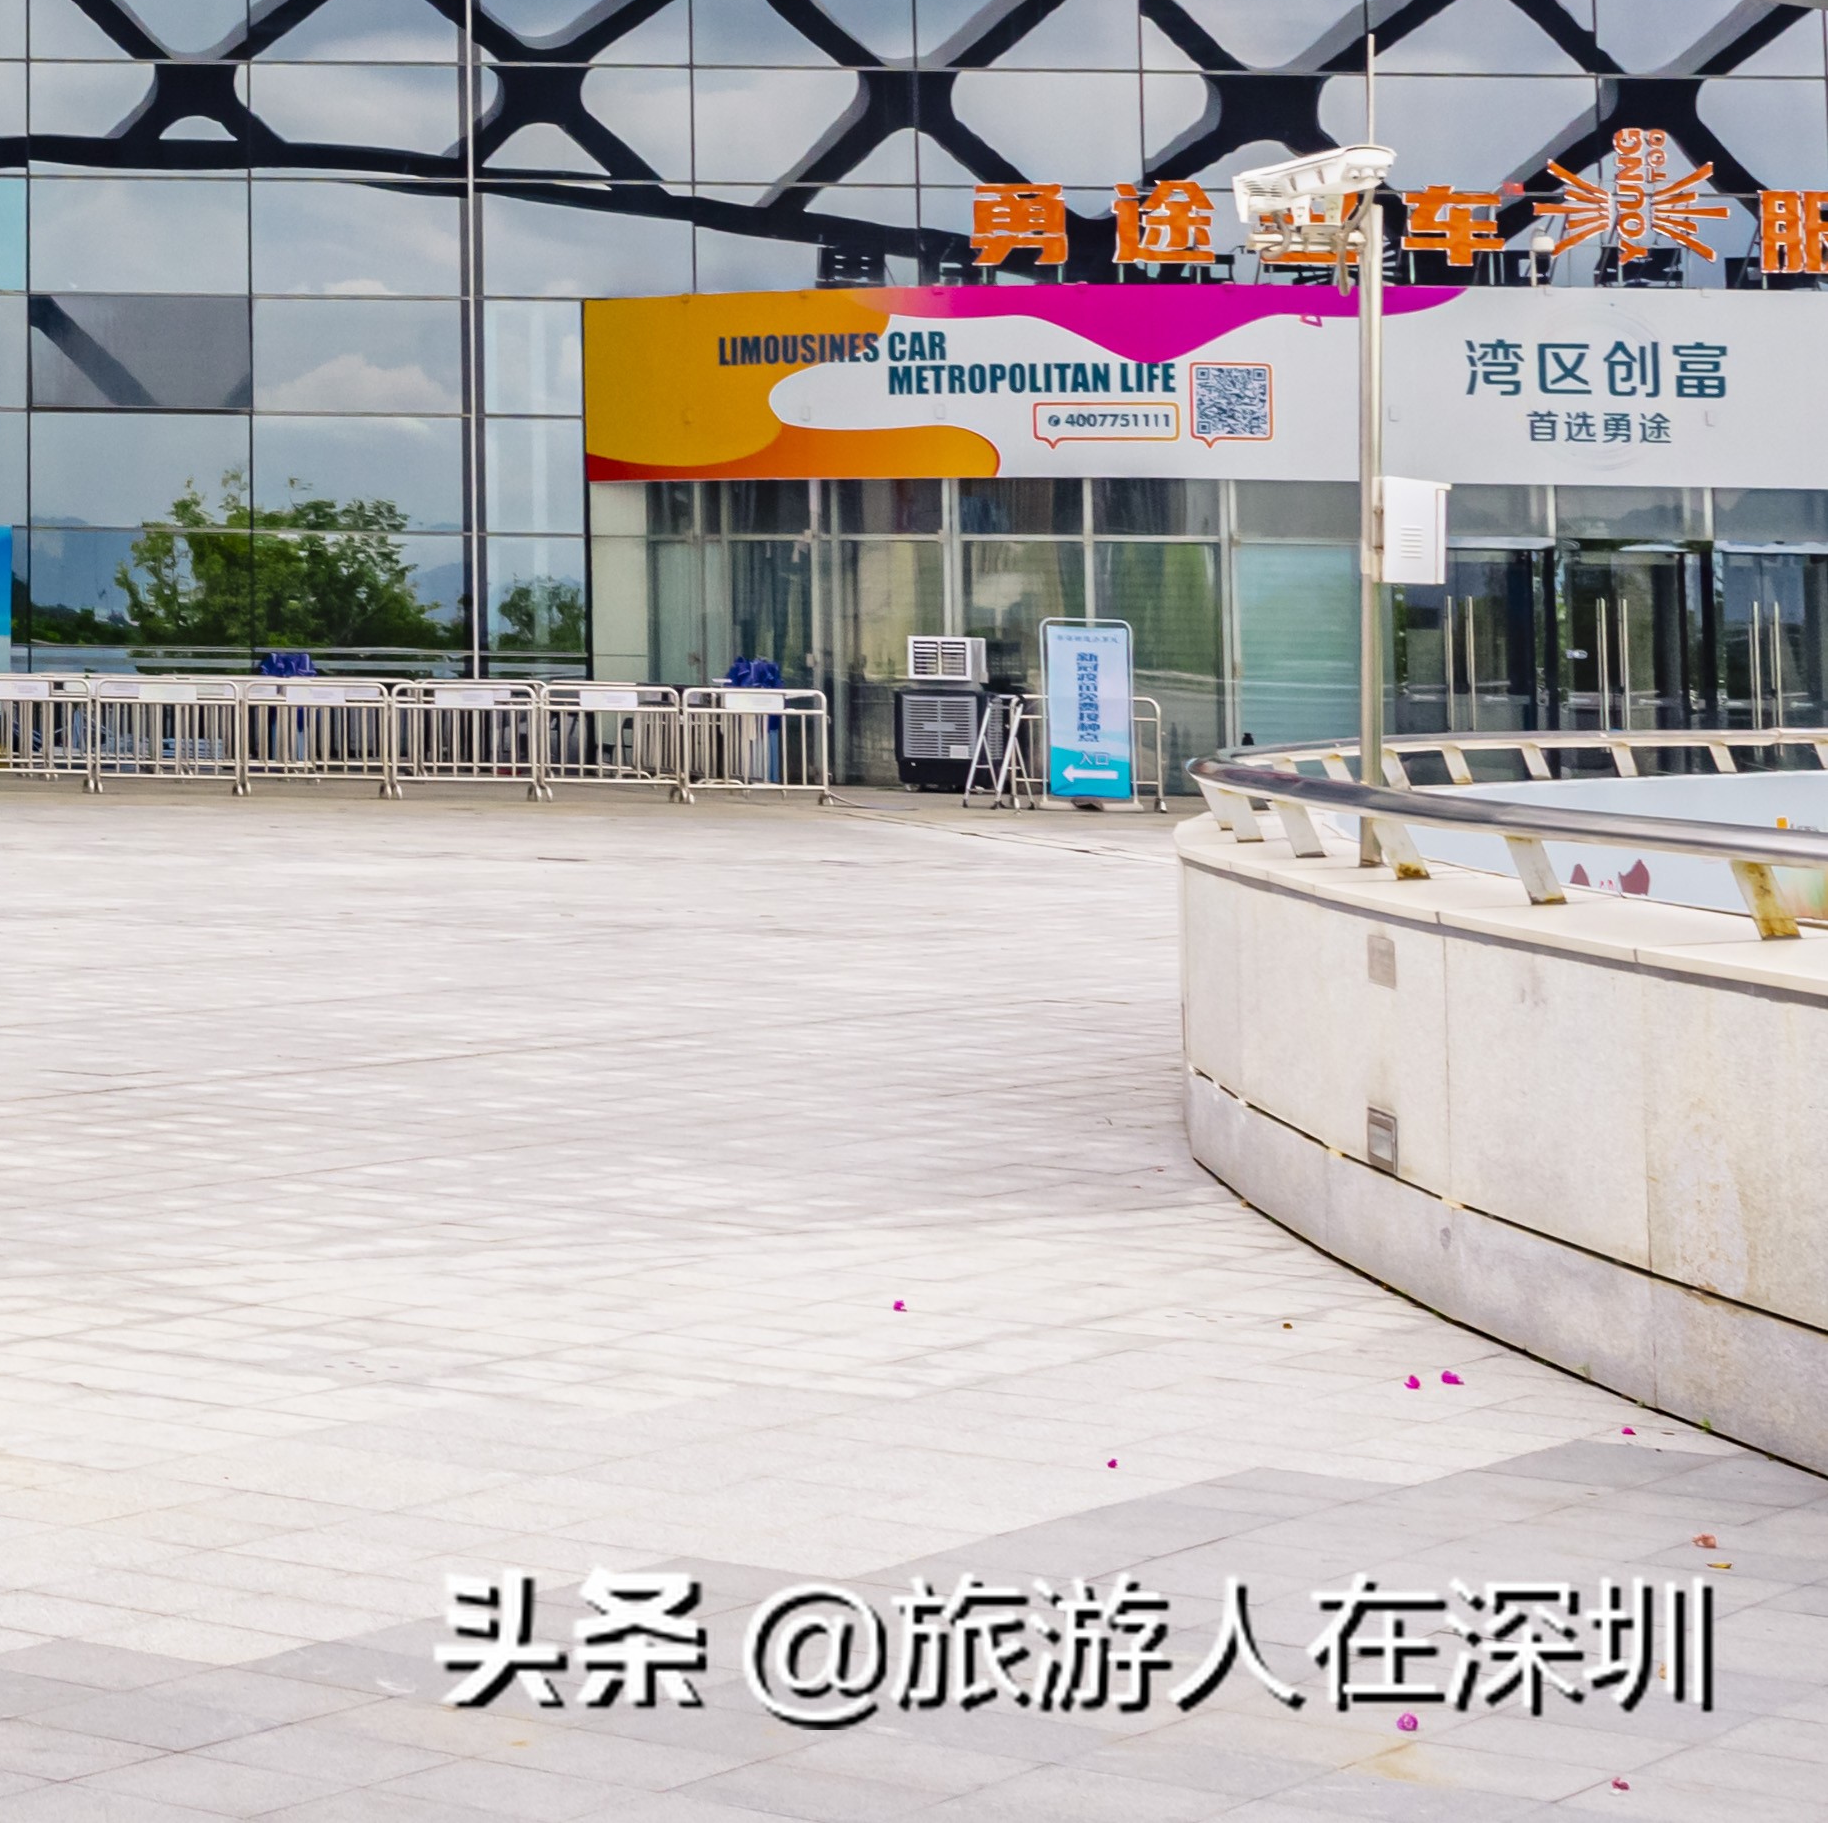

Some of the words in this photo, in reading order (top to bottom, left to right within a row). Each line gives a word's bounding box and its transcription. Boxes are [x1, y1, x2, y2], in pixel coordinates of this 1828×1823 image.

[1647, 128, 1667, 183] TOO
[1612, 127, 1649, 266] YOUNG
[970, 179, 1505, 267] 勇途车
[718, 332, 879, 365] LIMOUSINES
[887, 330, 947, 361] CAR
[888, 363, 1115, 395] METROPOLITAN
[1119, 362, 1176, 393] LIFE
[1464, 338, 1728, 399] 湾区创富
[1064, 412, 1171, 429] 4007751111
[1525, 410, 1673, 444] 首选勇途
[1079, 750, 1111, 766] 入口
